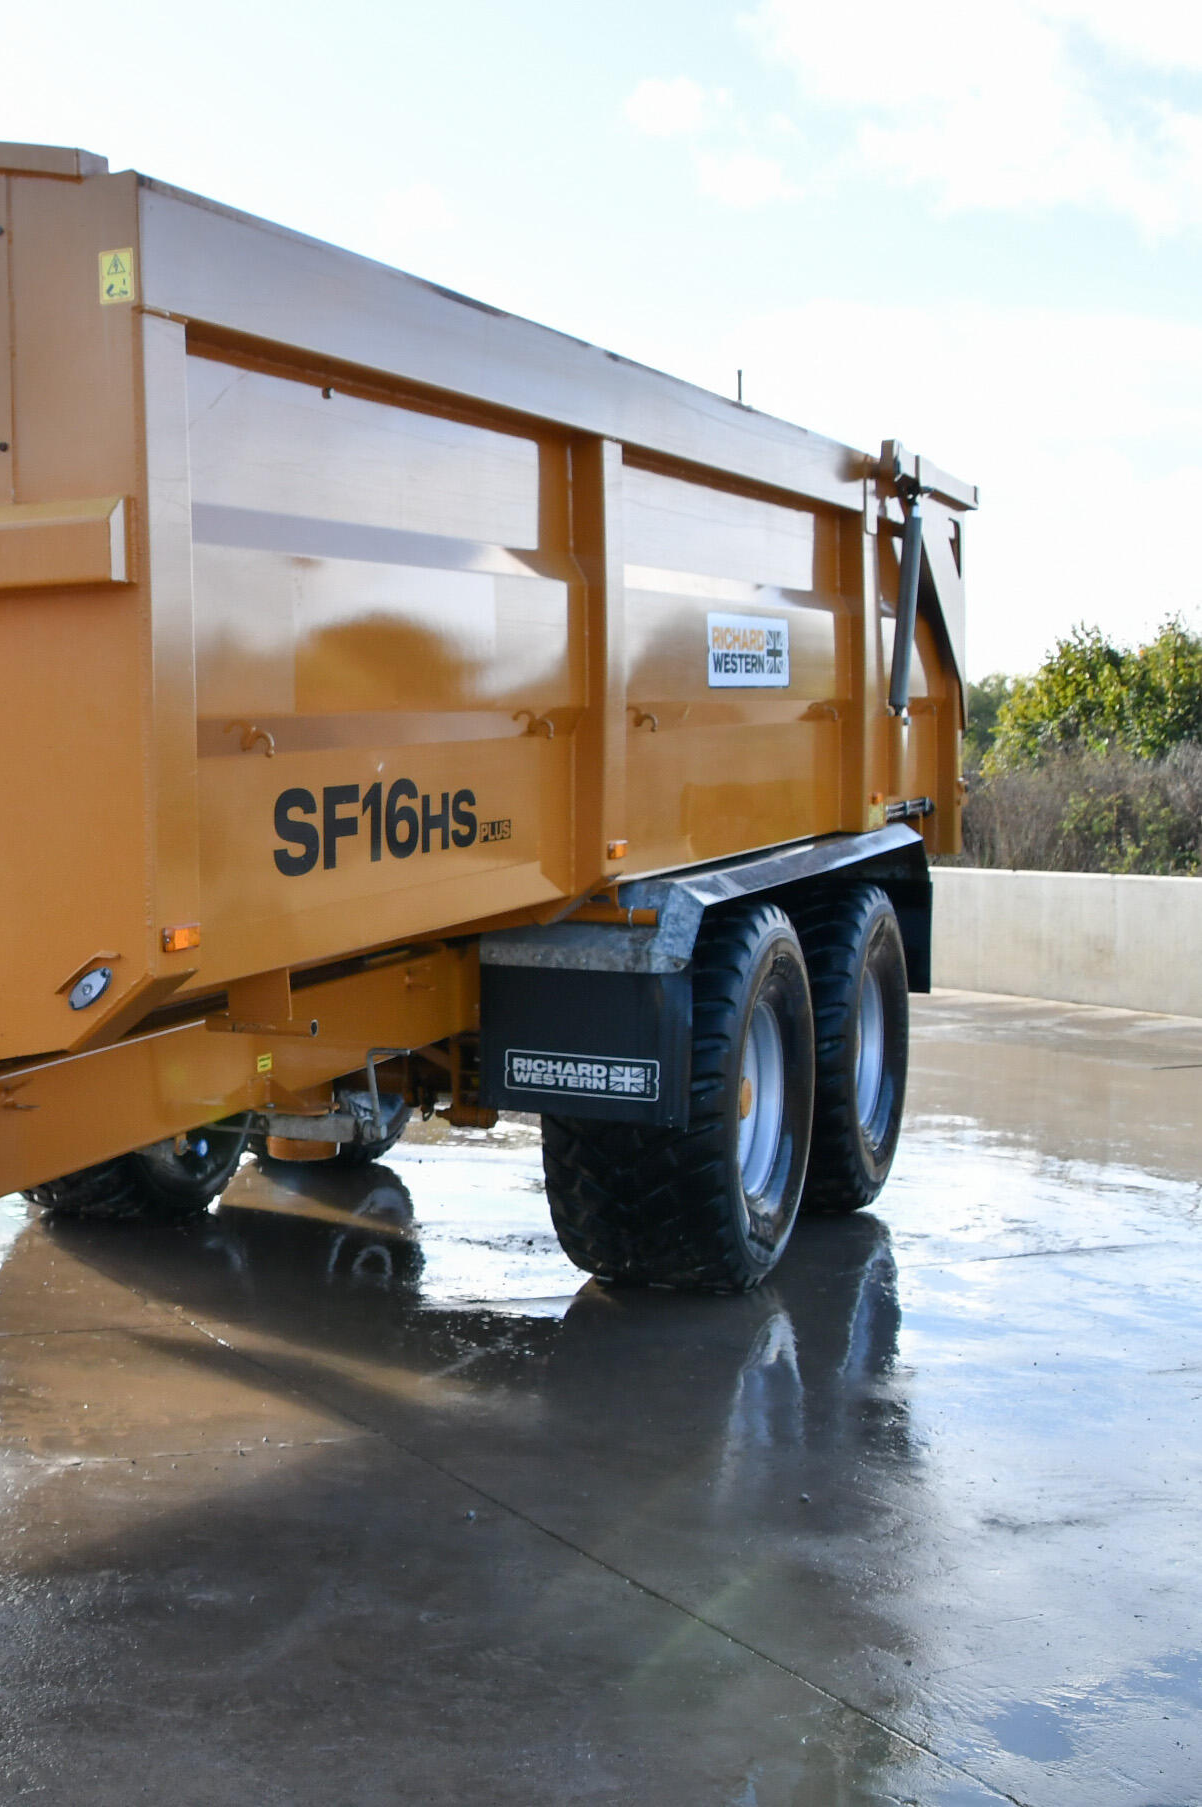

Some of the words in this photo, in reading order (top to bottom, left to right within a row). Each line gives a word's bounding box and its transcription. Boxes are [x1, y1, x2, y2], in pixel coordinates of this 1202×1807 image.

[712, 627, 765, 652] RICHARD
[713, 652, 765, 674] WESTERN
[274, 778, 478, 877] SF16HS
[480, 819, 511, 843] PLUS
[512, 1057, 608, 1078] RICHARD
[513, 1071, 606, 1090] WESTERN
